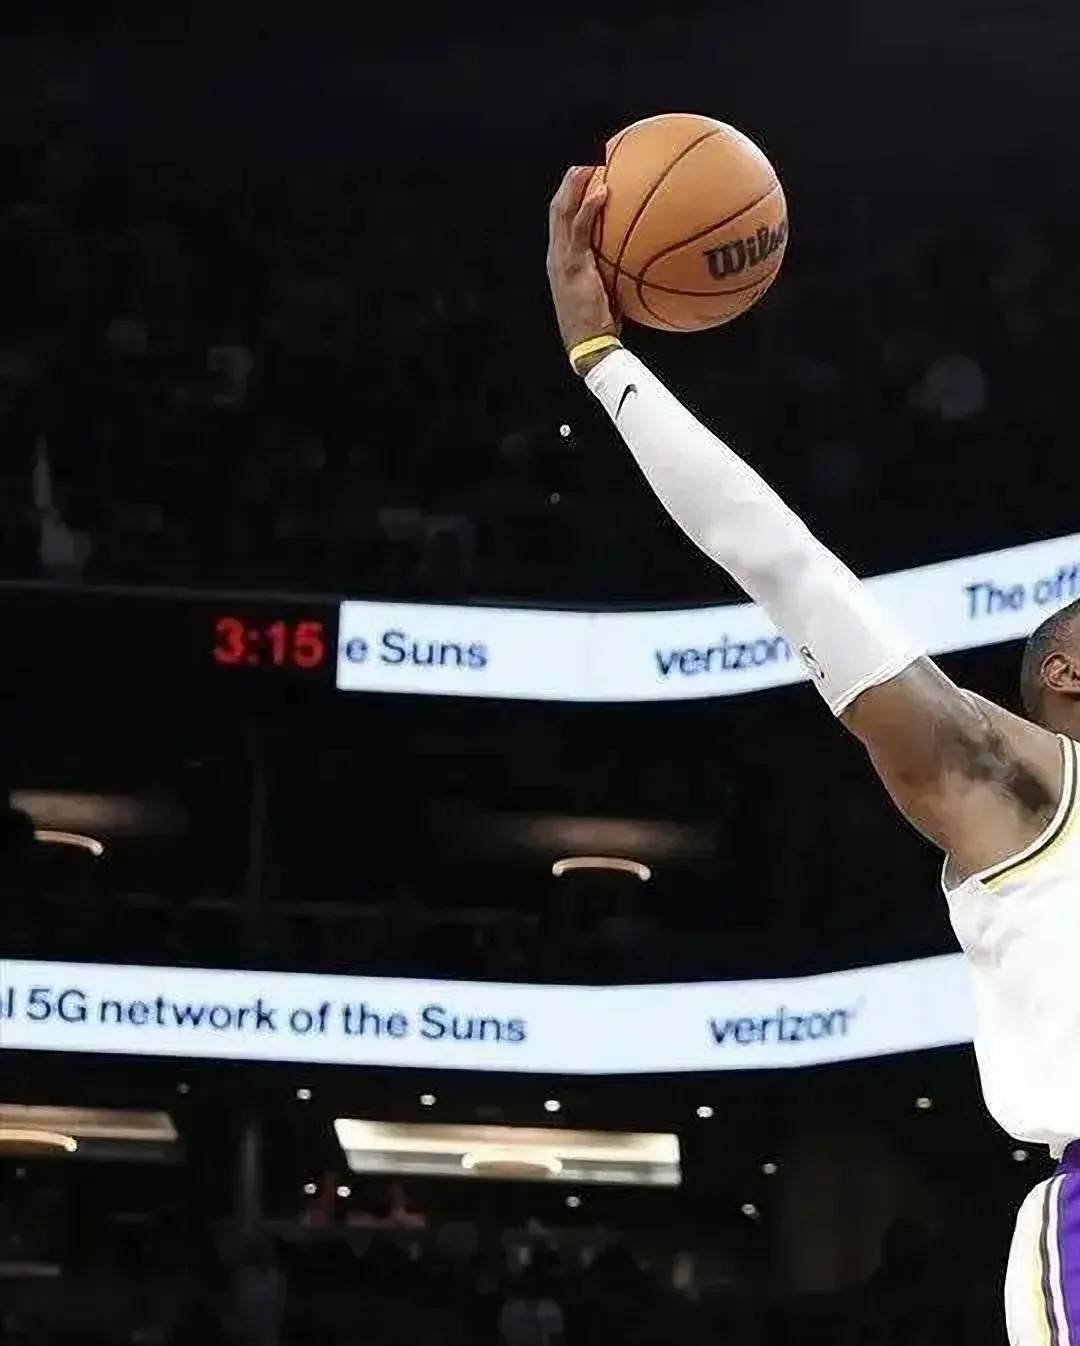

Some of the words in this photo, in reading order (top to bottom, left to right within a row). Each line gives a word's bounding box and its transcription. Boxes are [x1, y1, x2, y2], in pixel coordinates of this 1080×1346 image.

[963, 579, 1026, 618] The
[213, 616, 326, 668] 3:15
[381, 629, 489, 668] Suns
[655, 633, 792, 677] verizon
[26, 987, 87, 1023] 5G
[99, 994, 277, 1031] network
[289, 1000, 330, 1033] of
[343, 1001, 409, 1037] the
[420, 1004, 528, 1044] Suns
[709, 1004, 850, 1046] verizon
